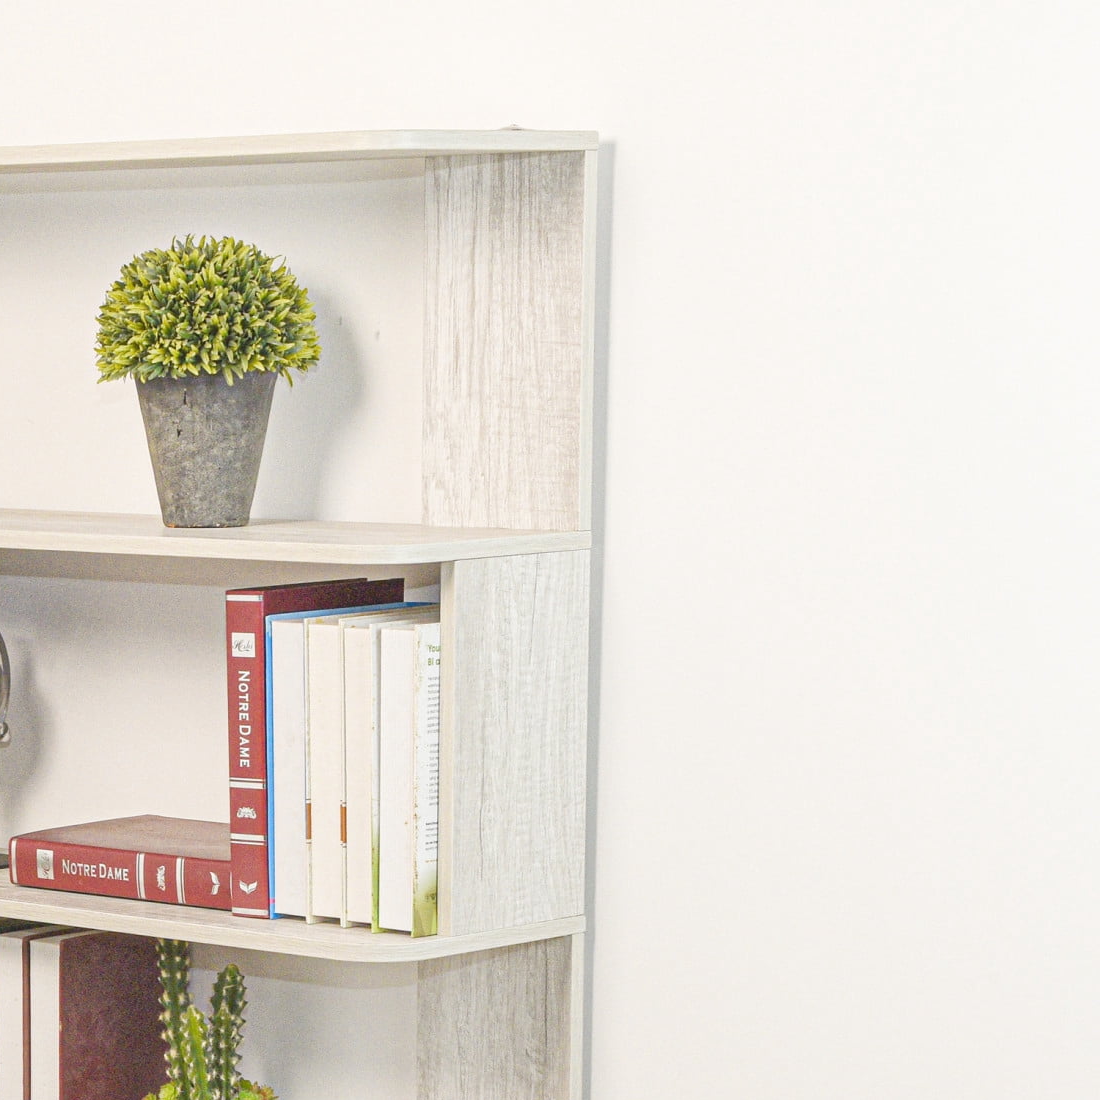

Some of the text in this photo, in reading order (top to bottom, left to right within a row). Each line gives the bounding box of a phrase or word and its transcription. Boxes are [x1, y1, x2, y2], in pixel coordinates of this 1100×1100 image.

[428, 645, 441, 653] You
[238, 670, 251, 768] NOTRE DAME
[61, 858, 97, 878] NOTRE
[98, 863, 130, 881] DAME
